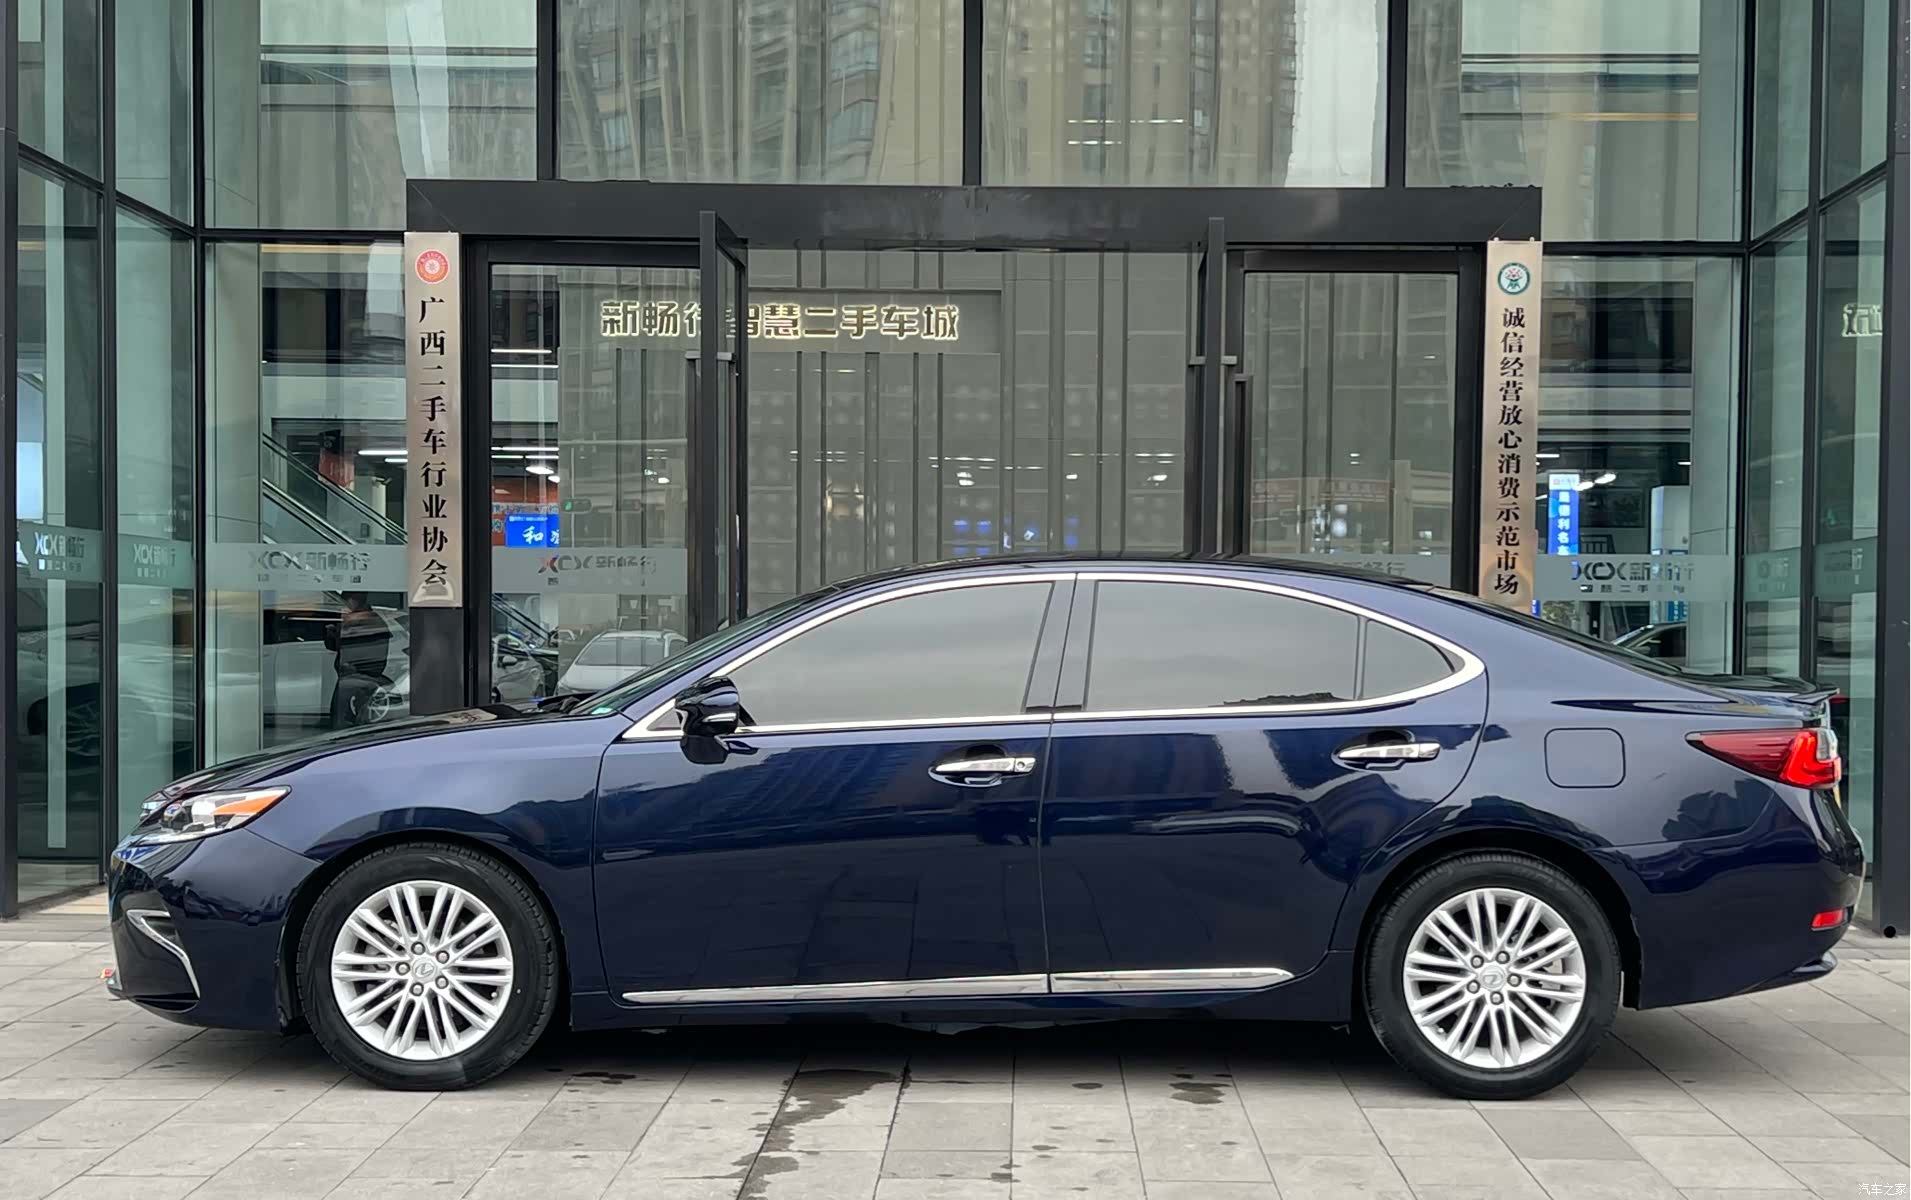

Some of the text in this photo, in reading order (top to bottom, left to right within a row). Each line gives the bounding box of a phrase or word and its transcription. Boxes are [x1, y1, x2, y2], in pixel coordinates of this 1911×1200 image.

[418, 296, 448, 586] 广西二手车行业协会
[1494, 306, 1526, 595] 诚信经营放心消费示范市场
